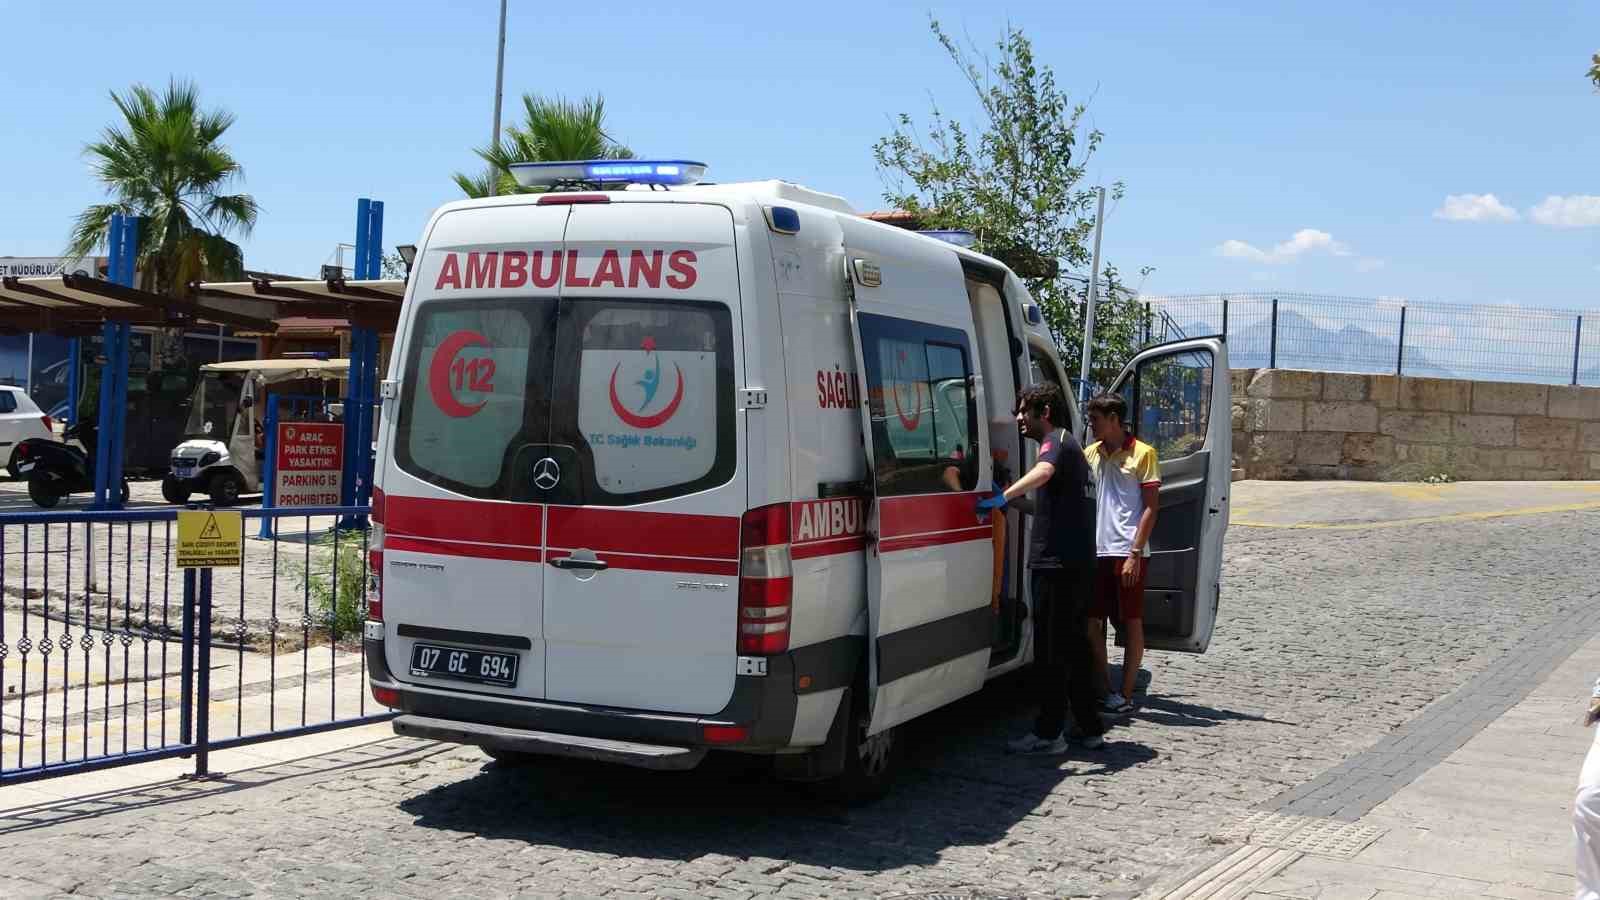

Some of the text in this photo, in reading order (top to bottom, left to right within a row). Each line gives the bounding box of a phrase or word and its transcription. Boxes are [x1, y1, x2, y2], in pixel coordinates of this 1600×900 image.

[434, 250, 698, 290] AMBULANS
[450, 357, 496, 392] 112
[300, 433, 323, 442] ARAÇ
[284, 445, 337, 455] PARK ETMEK
[282, 474, 337, 487] PARKING IS
[280, 494, 338, 506] PROHIBITED
[420, 648, 510, 678] 07 GC 694
